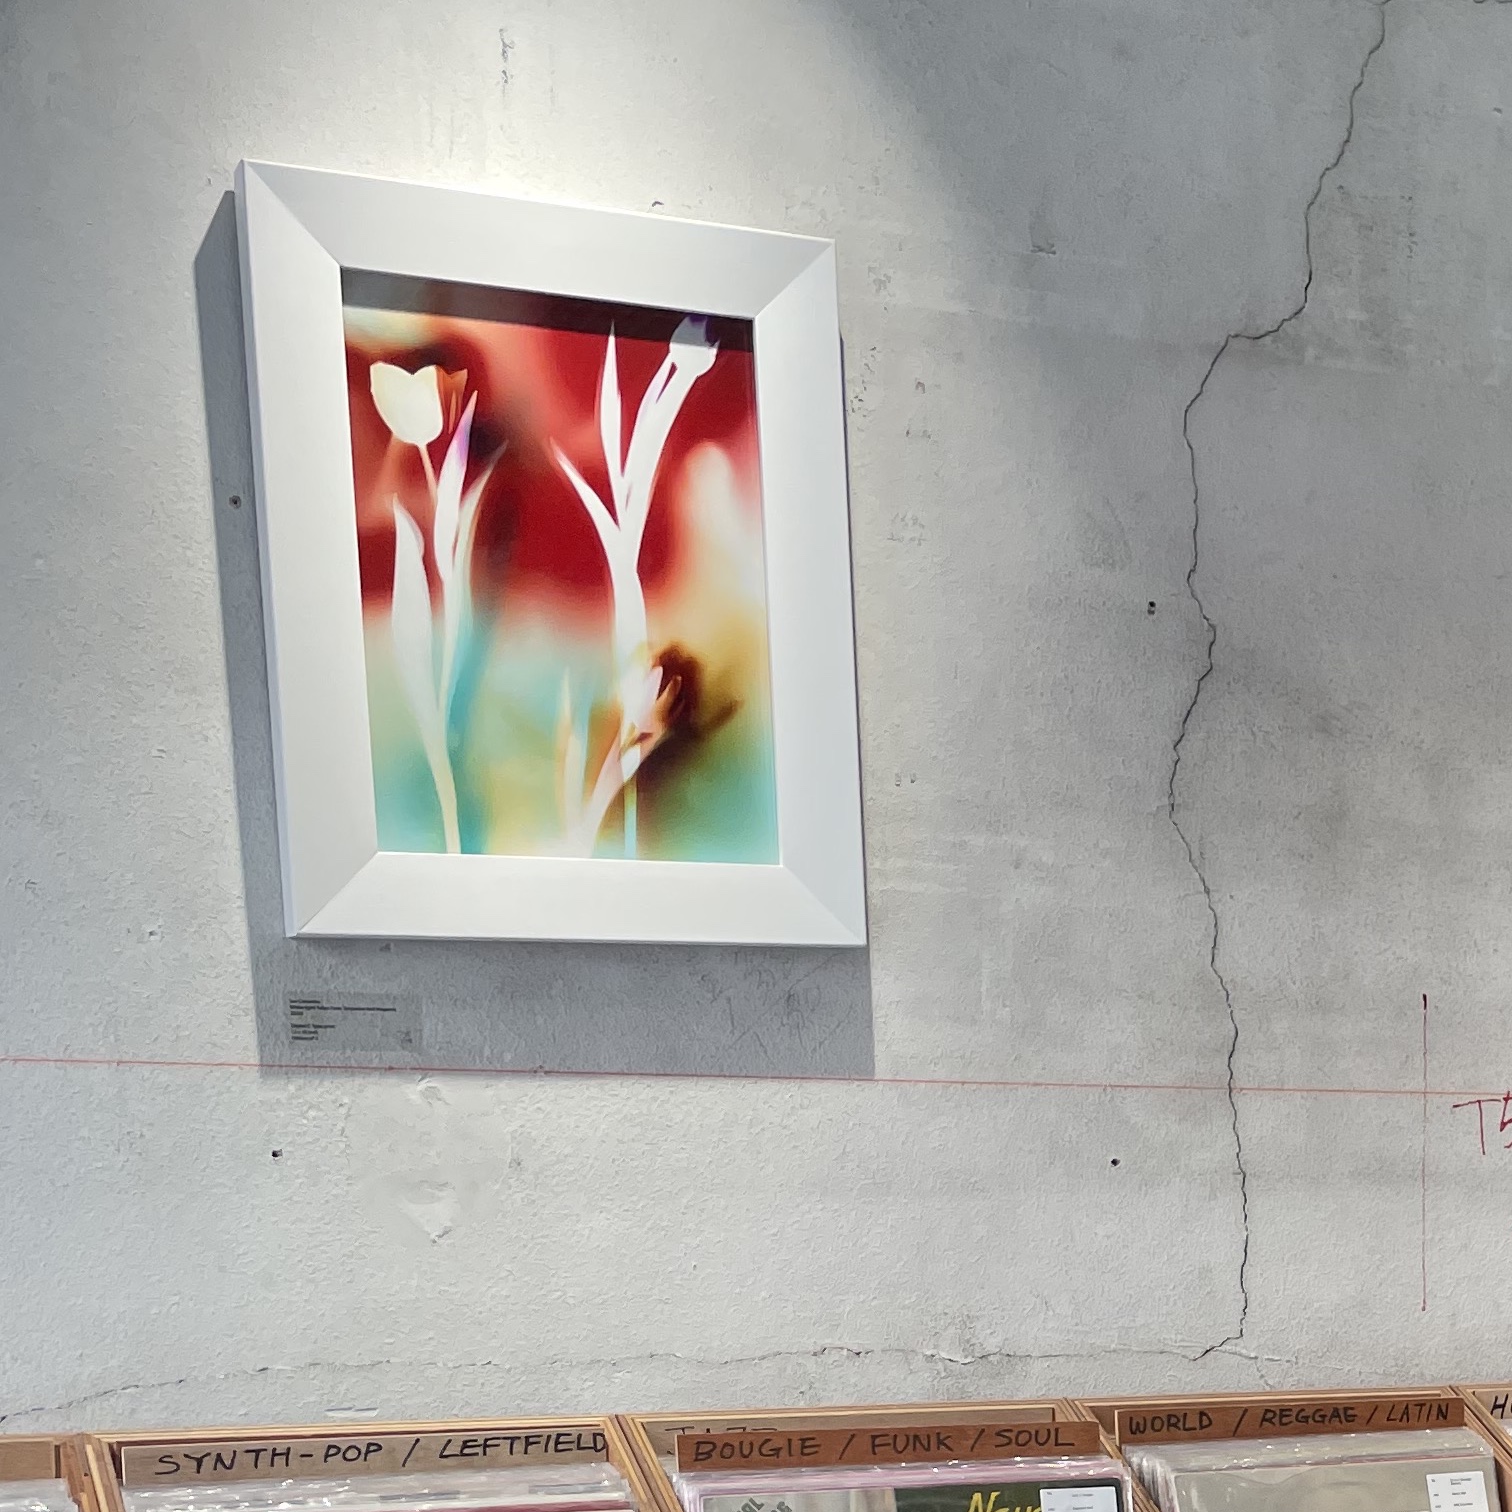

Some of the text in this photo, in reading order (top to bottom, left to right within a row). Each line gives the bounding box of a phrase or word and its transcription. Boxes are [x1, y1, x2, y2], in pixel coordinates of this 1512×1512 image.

[1128, 1410, 1213, 1436] WORLD
[1258, 1405, 1358, 1429] REGGAE
[1385, 1402, 1450, 1424] LATIN
[154, 1442, 383, 1475] SYNTH-POP
[438, 1431, 609, 1459] LEFTFIELD
[693, 1436, 821, 1462] BOUGIE
[870, 1431, 954, 1456] FUNK
[994, 1427, 1076, 1449] SOUL
